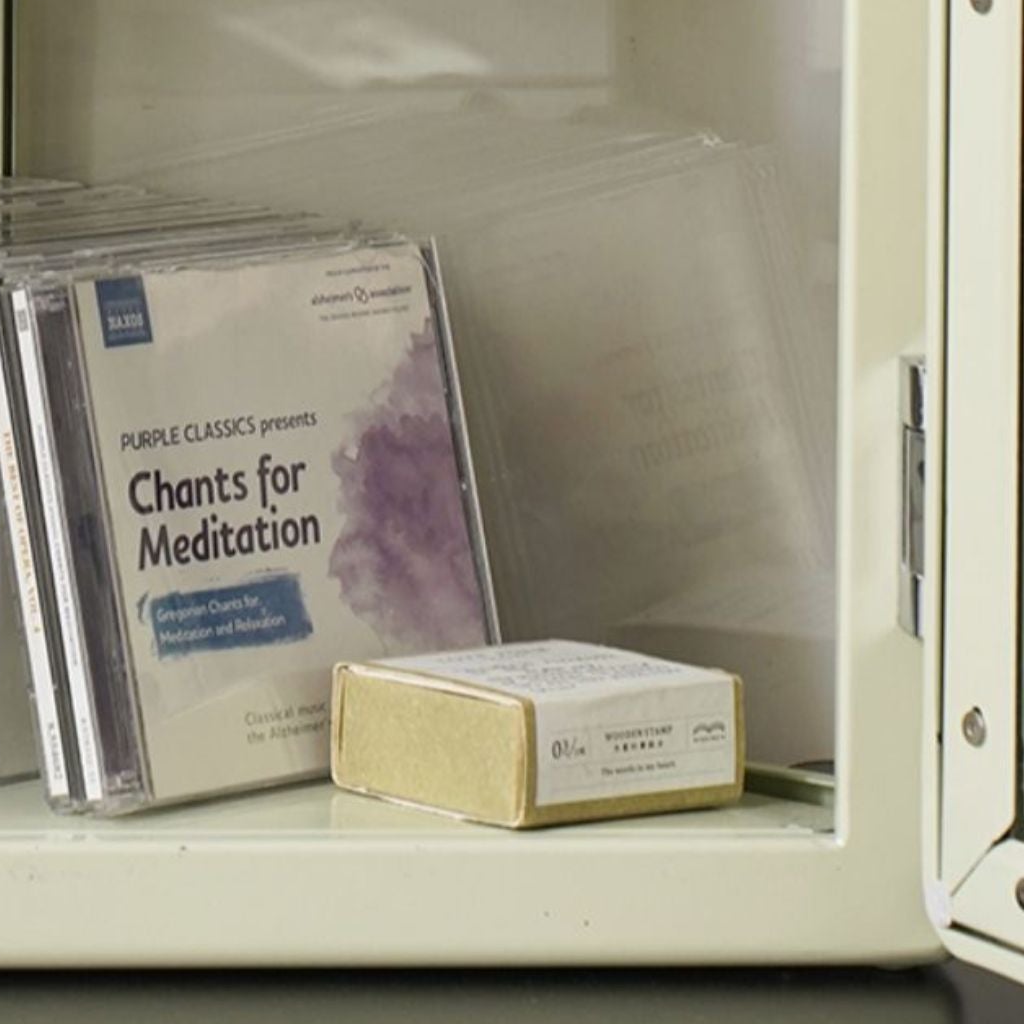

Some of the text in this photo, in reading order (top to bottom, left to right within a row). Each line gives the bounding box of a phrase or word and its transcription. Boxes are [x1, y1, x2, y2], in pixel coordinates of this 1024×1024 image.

[107, 312, 144, 331] NAXOS
[3, 432, 14, 458] THE
[121, 412, 317, 451] PURPLE CLASSICS presents
[8, 465, 20, 500] BEST
[129, 454, 306, 515] Chants for
[14, 504, 24, 523] OF
[139, 504, 321, 570] Meditation
[156, 594, 260, 623] Gregorian Chants for
[158, 612, 287, 643] Meditation and Relaxation
[244, 707, 294, 726] Classical
[247, 730, 265, 744] the
